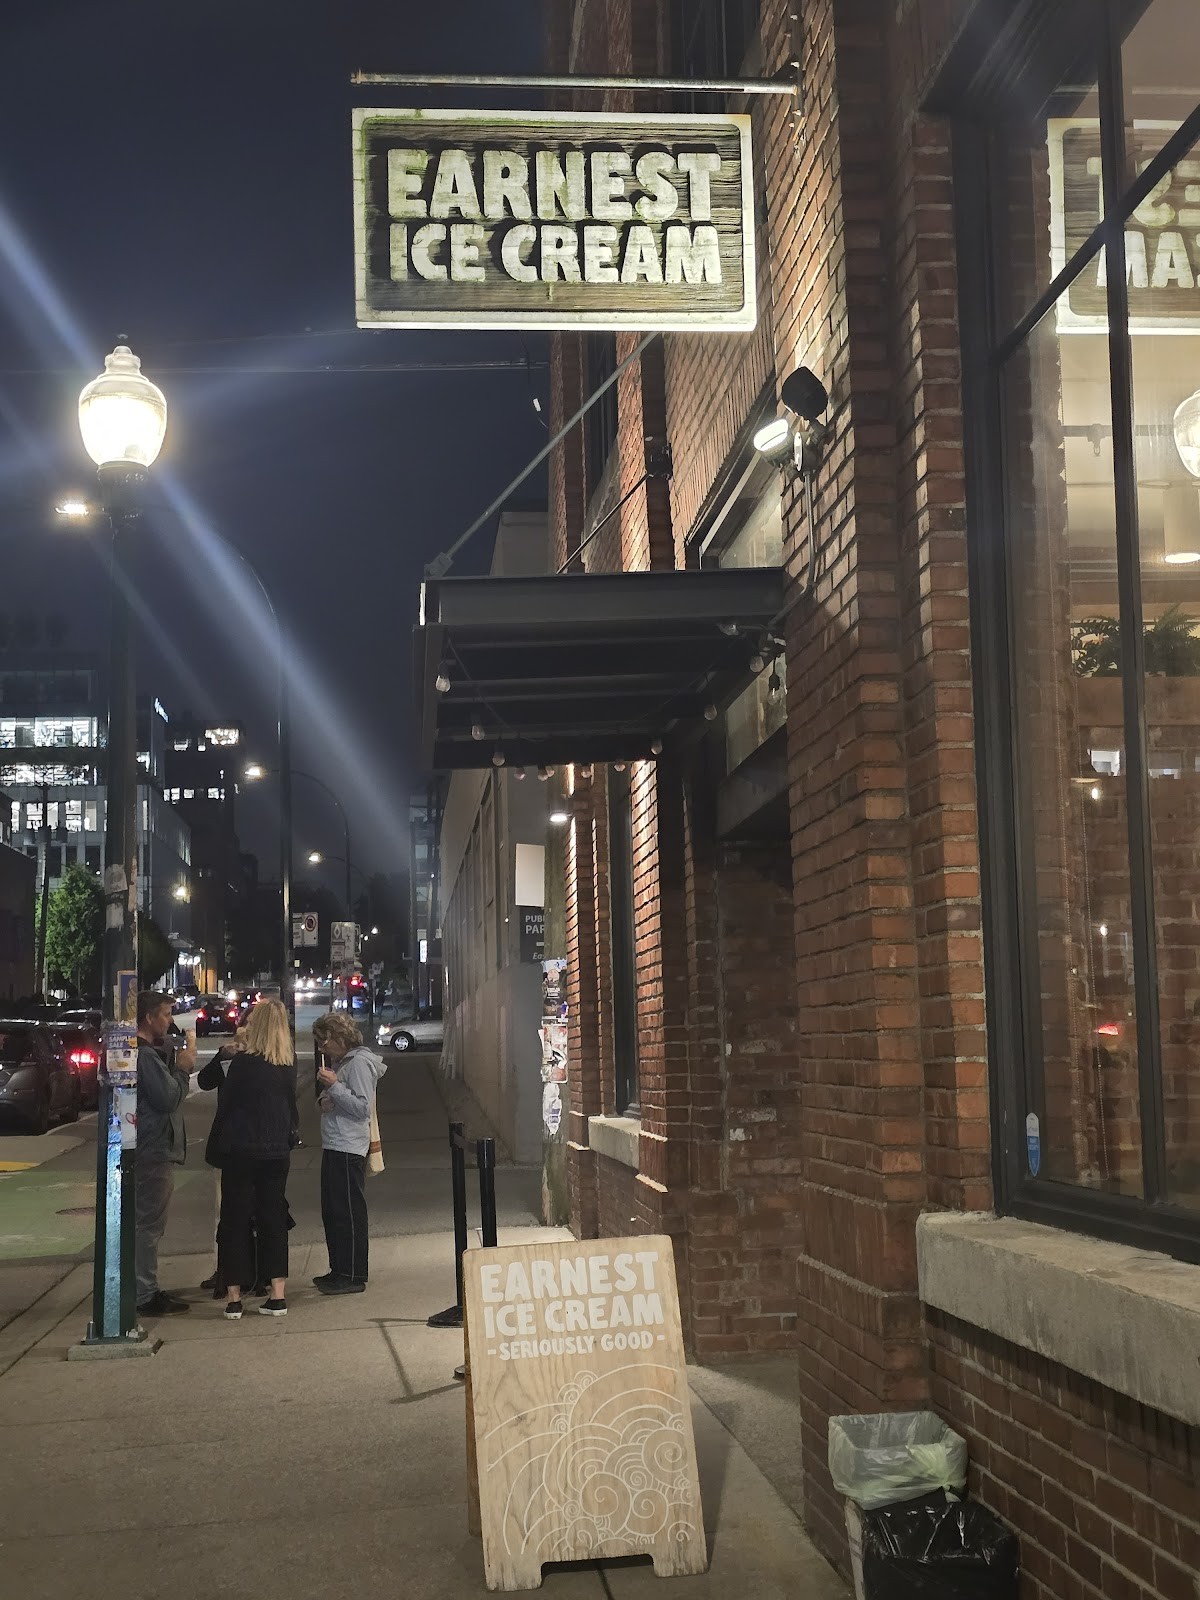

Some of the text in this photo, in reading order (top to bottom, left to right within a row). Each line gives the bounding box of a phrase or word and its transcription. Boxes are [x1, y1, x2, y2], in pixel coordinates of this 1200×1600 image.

[387, 149, 721, 222] EARNEST
[389, 222, 723, 284] ICE CREAM
[480, 1251, 659, 1303] EARNEST
[483, 1293, 665, 1339] ICE CREAM
